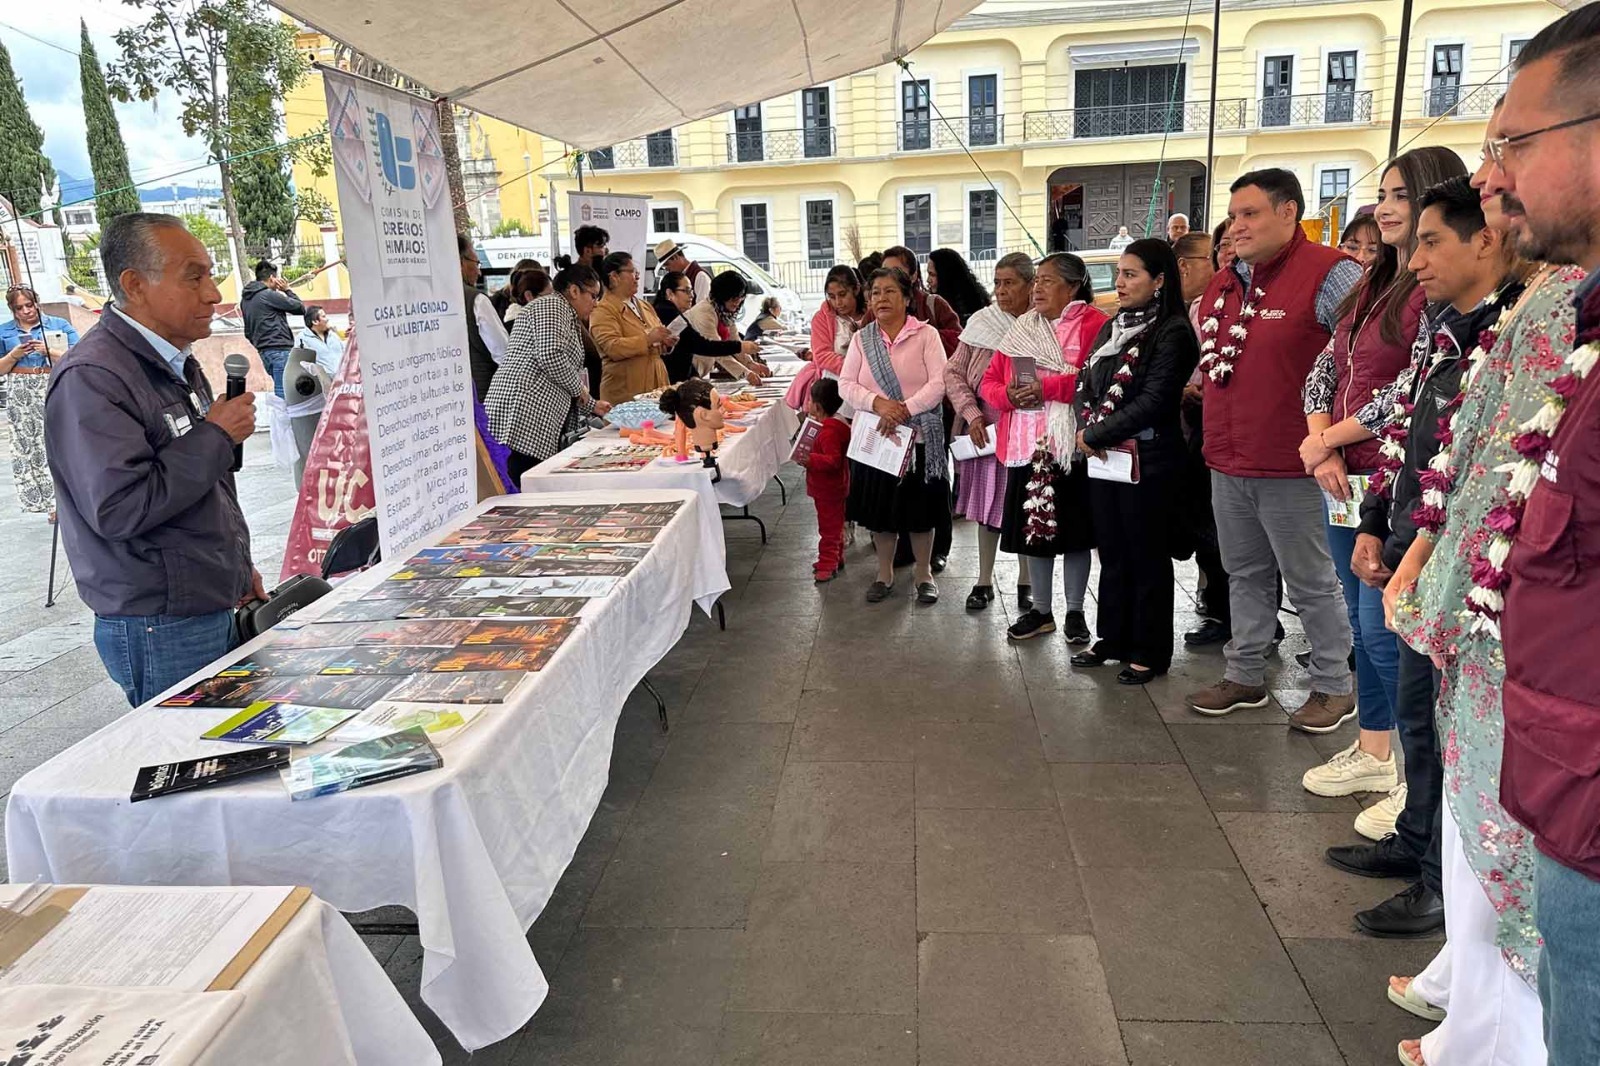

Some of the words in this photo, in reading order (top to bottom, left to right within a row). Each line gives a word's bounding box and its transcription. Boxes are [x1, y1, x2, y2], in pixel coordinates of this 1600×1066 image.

[614, 208, 642, 218] CAMPO
[383, 221, 424, 237] DRECHOS
[385, 239, 426, 254] HMAOS
[374, 305, 396, 321] CASA
[371, 361, 395, 377] Somos
[453, 380, 465, 393] los
[453, 415, 467, 427] los
[458, 447, 468, 461] el
